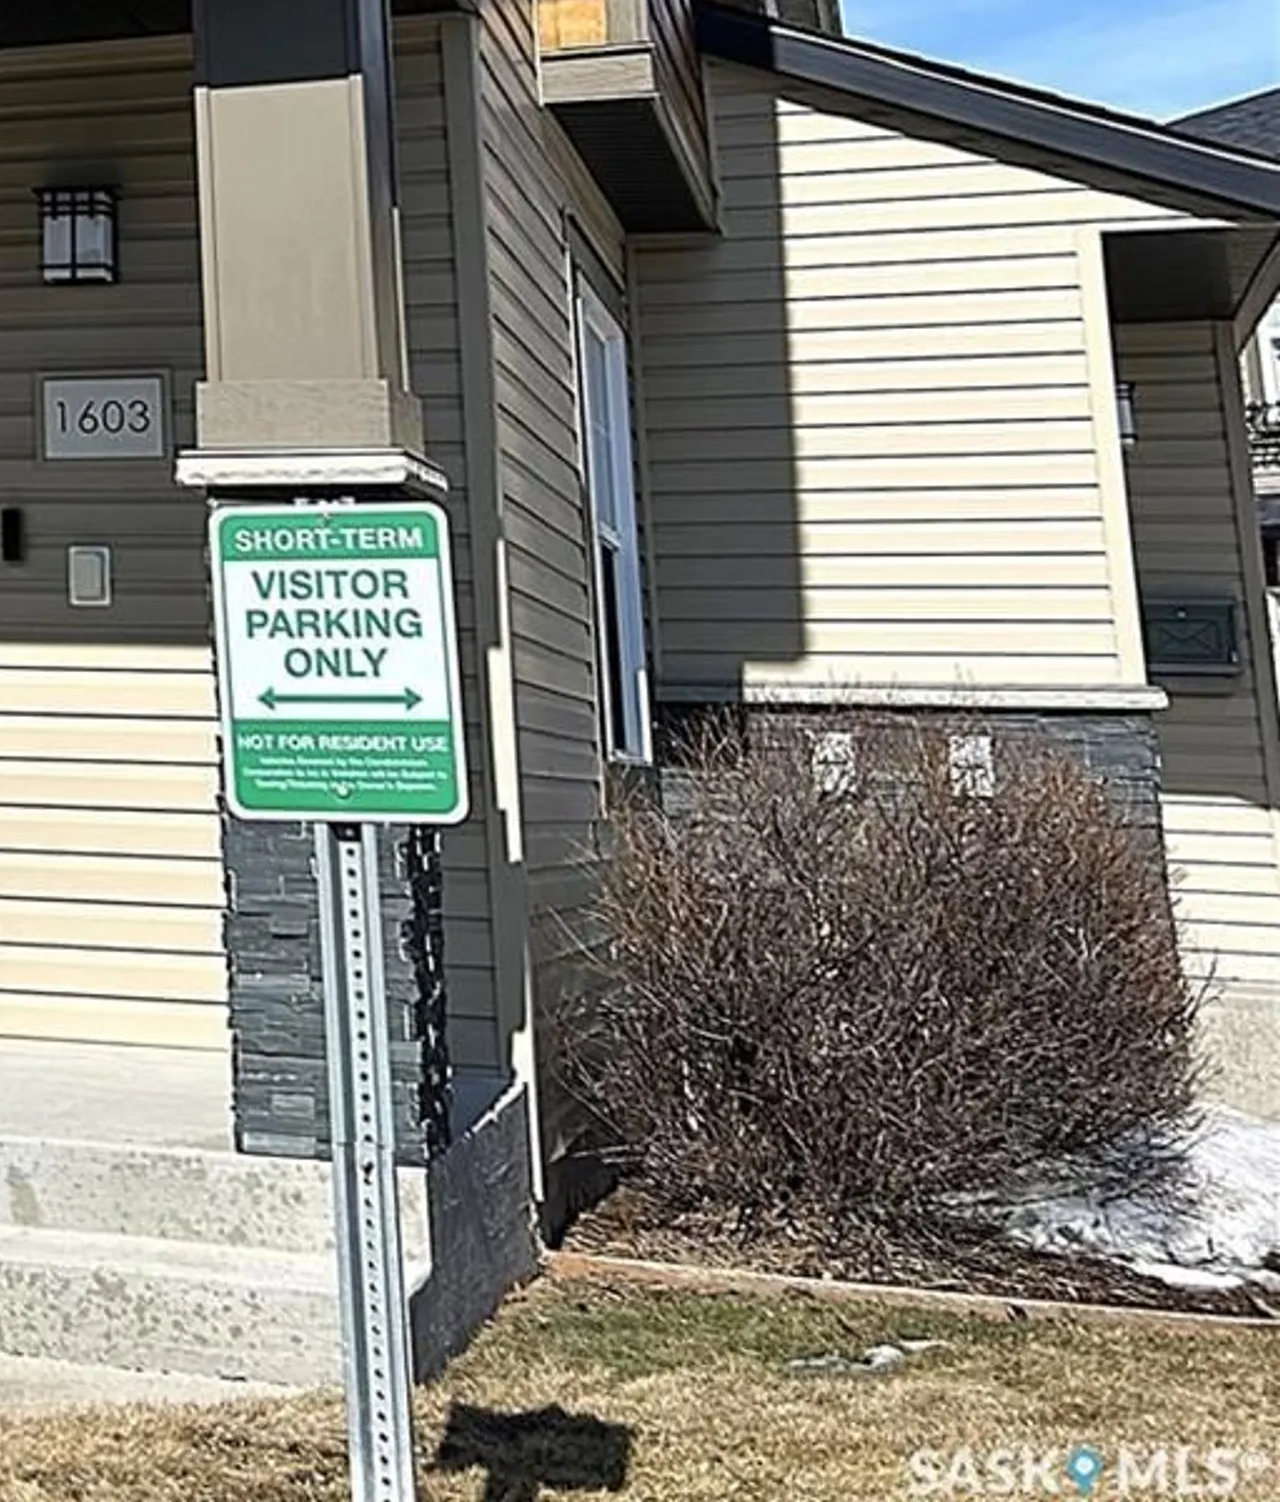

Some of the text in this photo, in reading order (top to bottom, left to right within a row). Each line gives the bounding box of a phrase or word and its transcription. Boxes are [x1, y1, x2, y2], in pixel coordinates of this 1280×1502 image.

[57, 400, 149, 433] 1603
[236, 527, 423, 549] SHORT-TERM
[251, 569, 408, 599] VISITOR
[245, 608, 423, 638] PARKING
[284, 648, 388, 678] ONLY
[239, 734, 448, 752] NOT FOR RESIDENT USE
